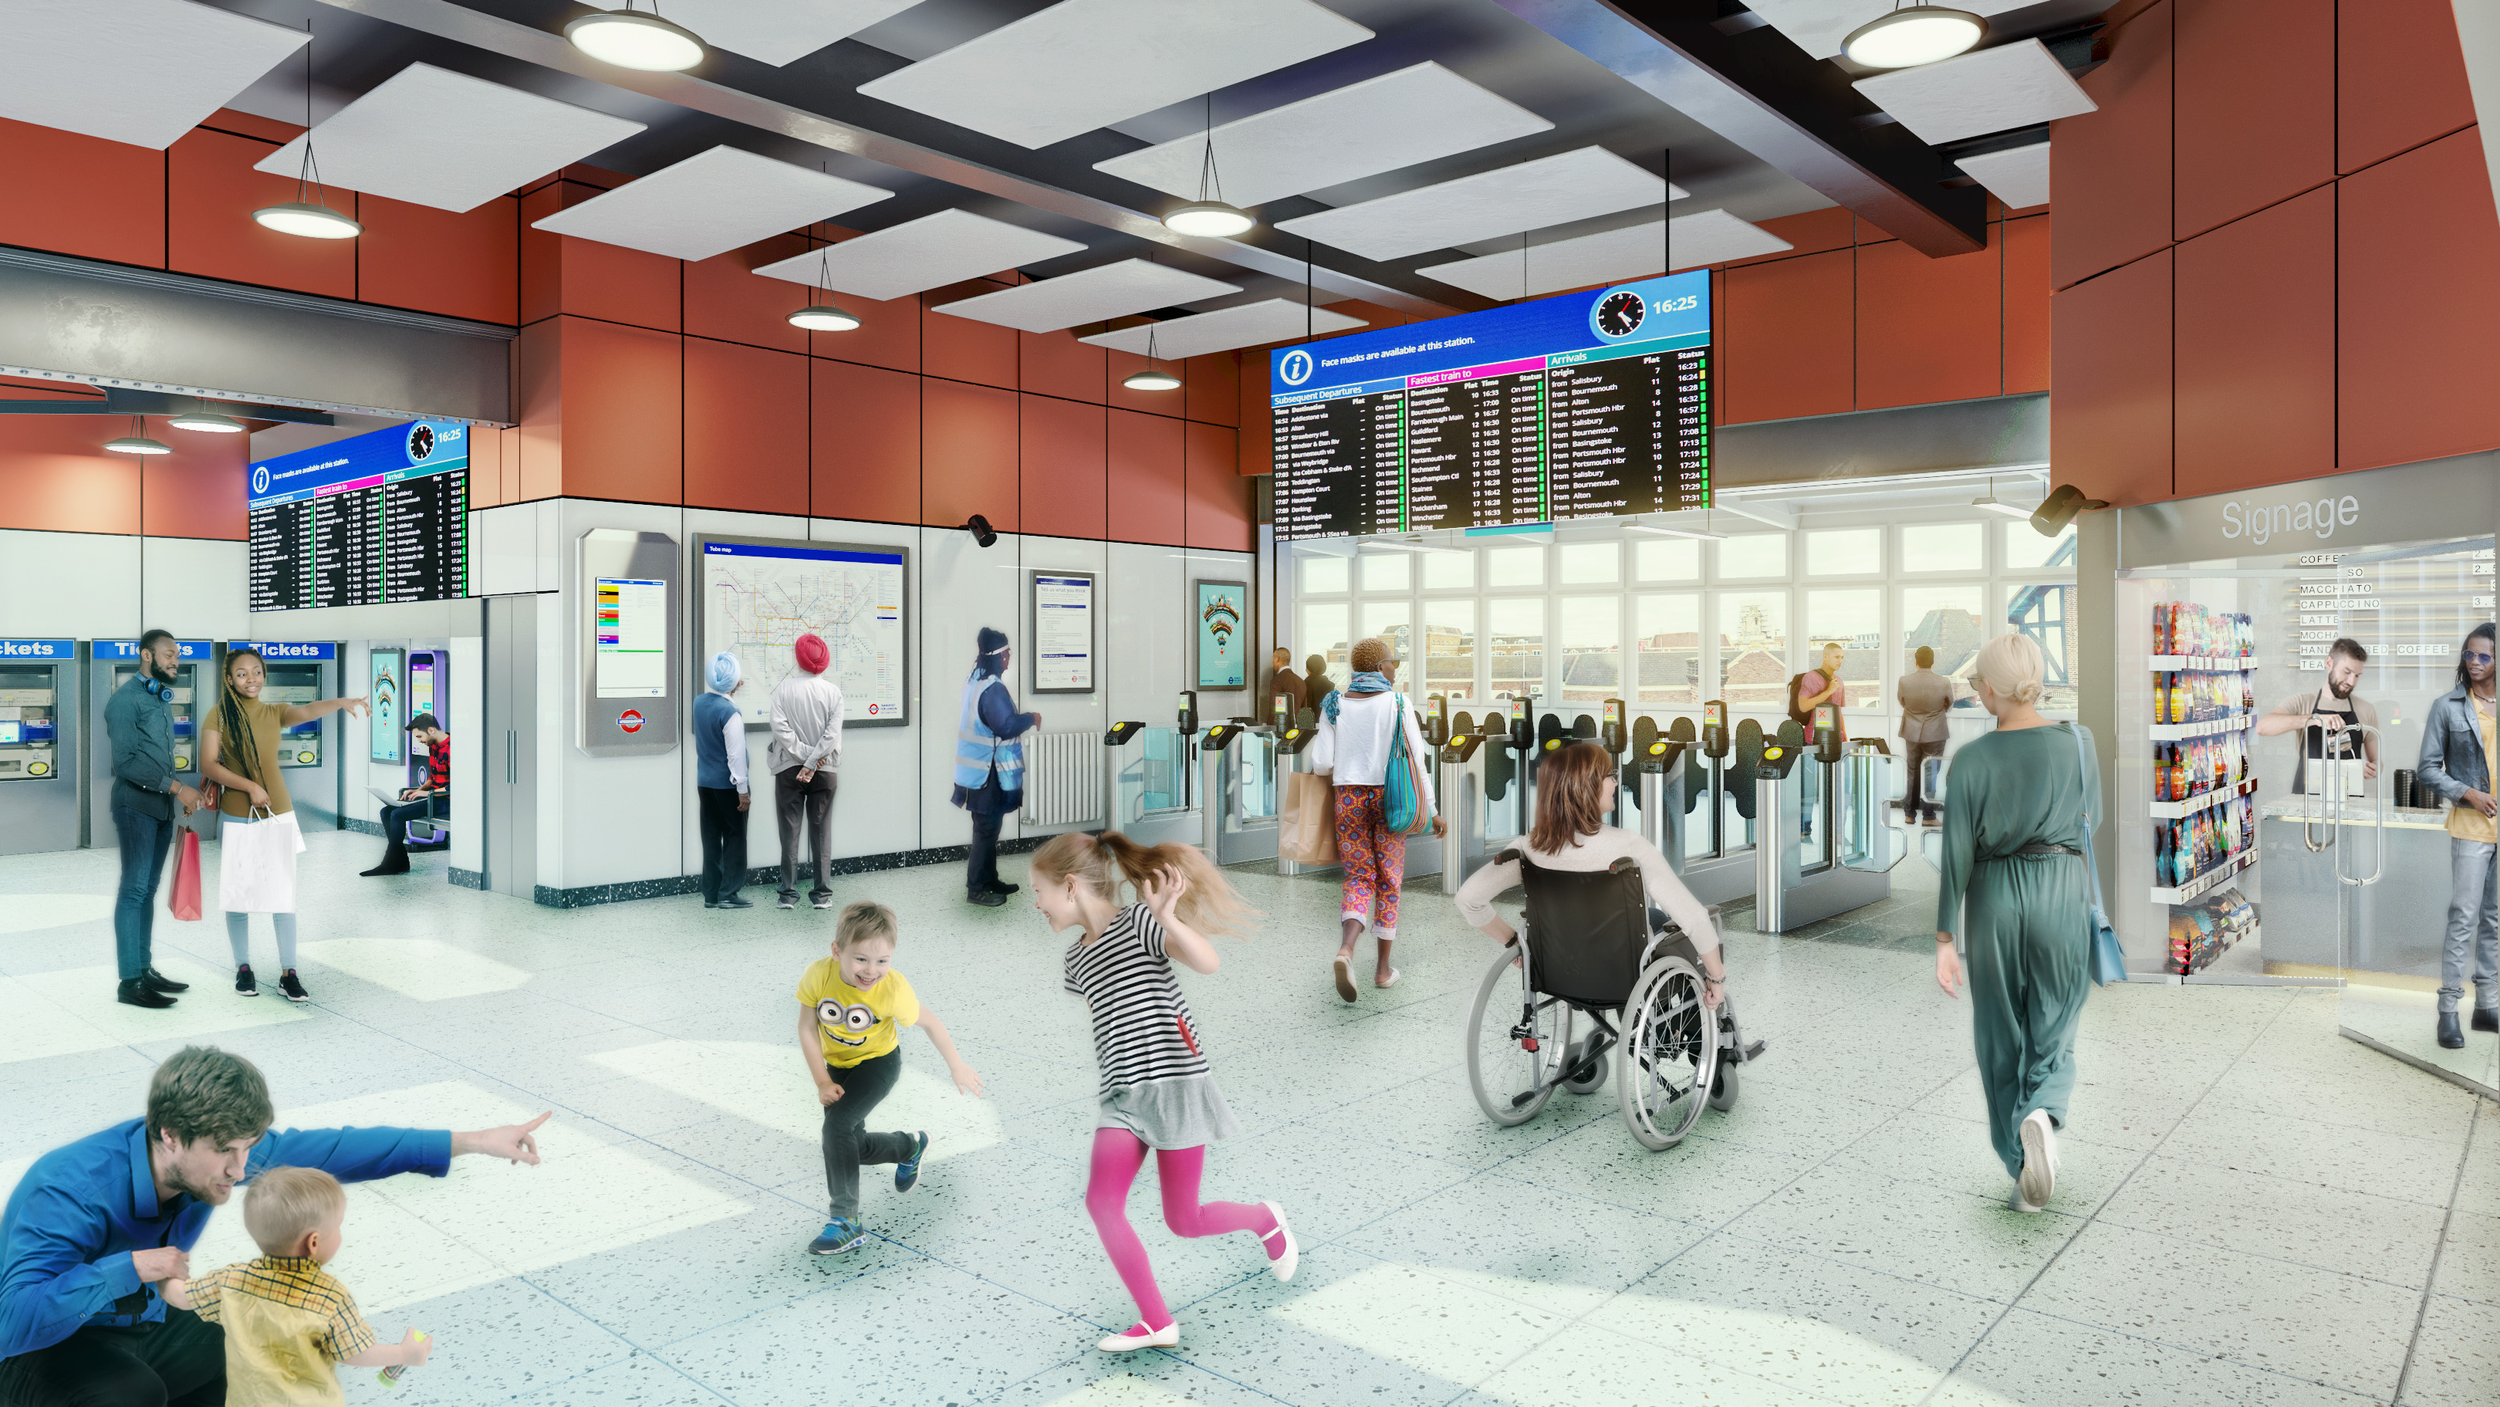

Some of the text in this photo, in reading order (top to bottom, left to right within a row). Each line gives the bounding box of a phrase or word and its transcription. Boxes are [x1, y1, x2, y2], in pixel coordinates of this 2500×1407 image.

[1653, 295, 1697, 314] 16:25
[1340, 354, 1364, 364] masks
[1381, 346, 1416, 357] available
[1428, 342, 1442, 350] this
[1444, 338, 1475, 347] station.
[1551, 353, 1587, 365] Arrivals
[1552, 368, 1574, 377] Origin
[1411, 374, 1439, 385] Fastest
[1441, 371, 1461, 381] train
[1572, 377, 1602, 385] Salisbury
[1411, 387, 1448, 396] Destination
[1572, 384, 1617, 395] Bournemouth
[1275, 386, 1362, 405] Subsequent Departures
[1292, 404, 1325, 413] Destination
[1572, 406, 1610, 416] Portsmouth
[438, 428, 461, 443] 16:25
[1572, 426, 1618, 436] Bournemouth
[1573, 438, 1612, 447] Basingstoke
[1573, 448, 1611, 457] Portsmouth
[1573, 458, 1611, 468] Portsmouth
[387, 472, 405, 481] Arrivals
[1573, 479, 1619, 489] Bournemouth
[1574, 501, 1612, 509] Portsmouth
[2222, 495, 2359, 545] Signage
[2300, 554, 2347, 564] COFFE
[2300, 584, 2371, 593] MACCHIATO
[2301, 600, 2379, 609] CAPPUCCINO
[2302, 616, 2338, 624] LATTE
[0, 642, 53, 655] kets
[249, 644, 319, 656] Tickets
[2398, 646, 2447, 654] COFFEE
